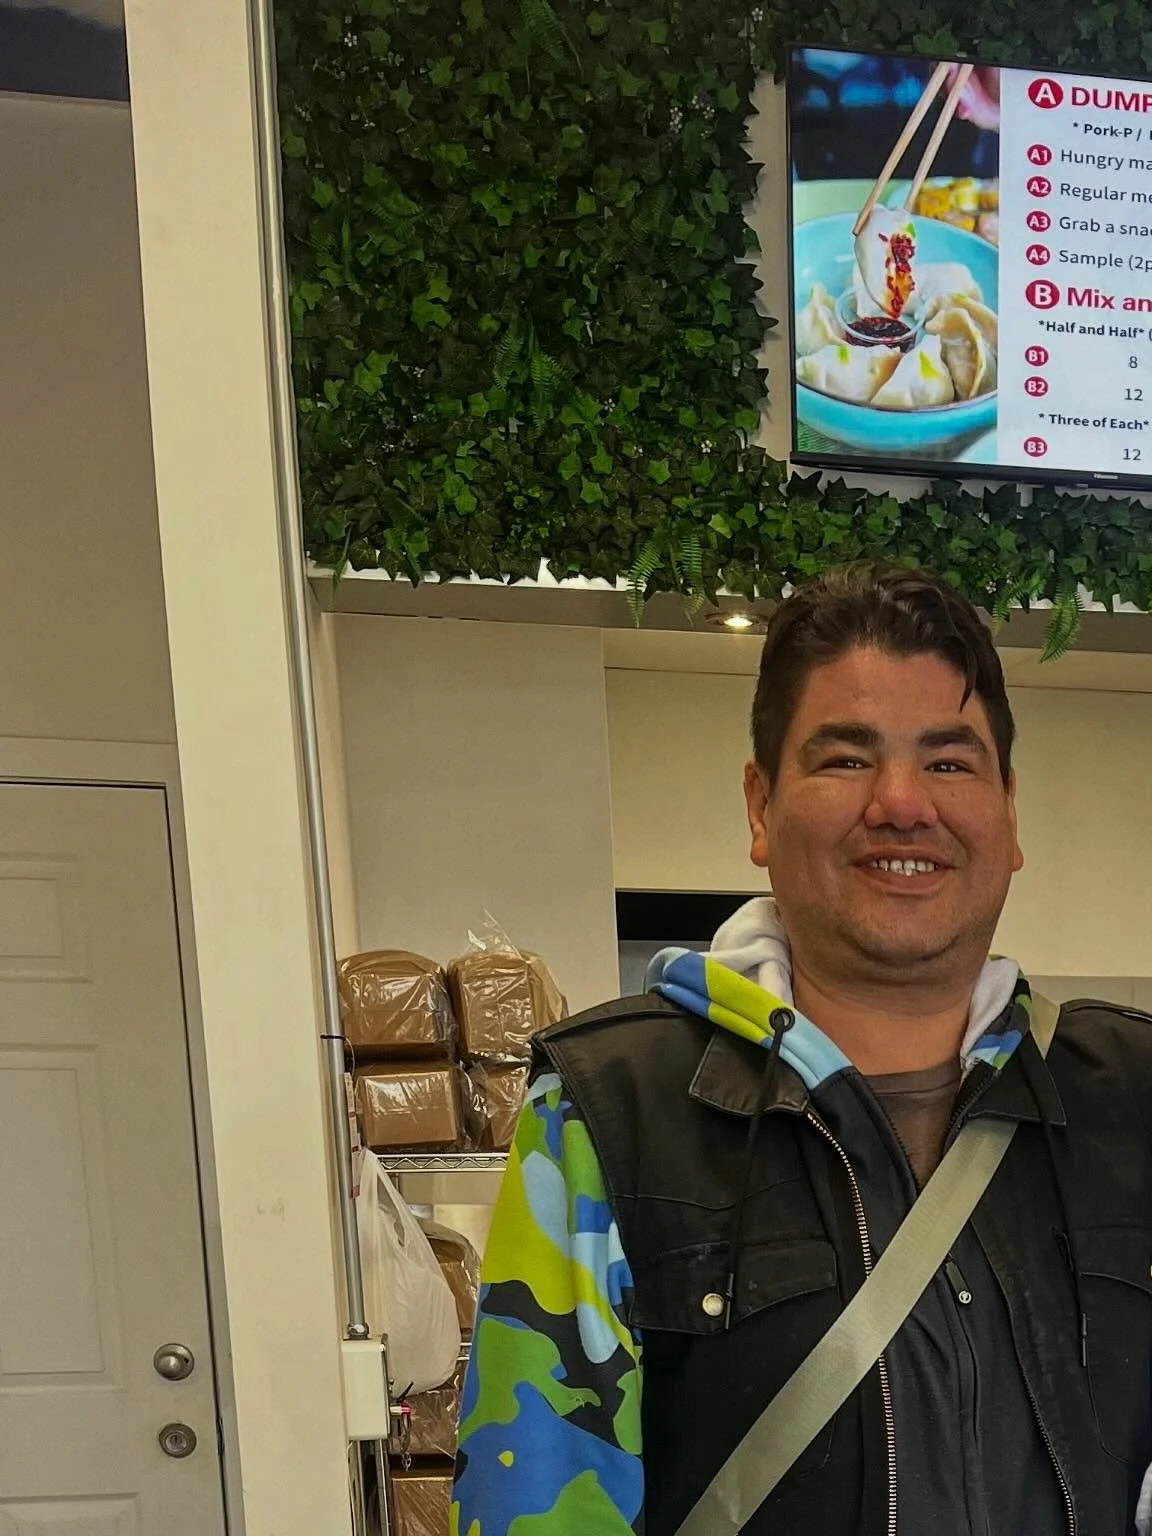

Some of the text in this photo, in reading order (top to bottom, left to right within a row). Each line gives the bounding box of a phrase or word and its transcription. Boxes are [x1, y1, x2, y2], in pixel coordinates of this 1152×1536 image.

[1084, 123, 1133, 139] Pork-P
[1060, 149, 1123, 171] Hungry
[1060, 183, 1127, 204] Regular
[1059, 216, 1100, 234] Grab
[1106, 224, 1115, 235] a
[1058, 249, 1123, 269] Sample
[1067, 287, 1115, 309] Mix
[1079, 323, 1105, 336] and
[1129, 356, 1138, 369] 8
[1124, 388, 1144, 402] 12
[1049, 414, 1090, 428] Three
[1093, 416, 1108, 429] of
[1123, 448, 1141, 462] 12
